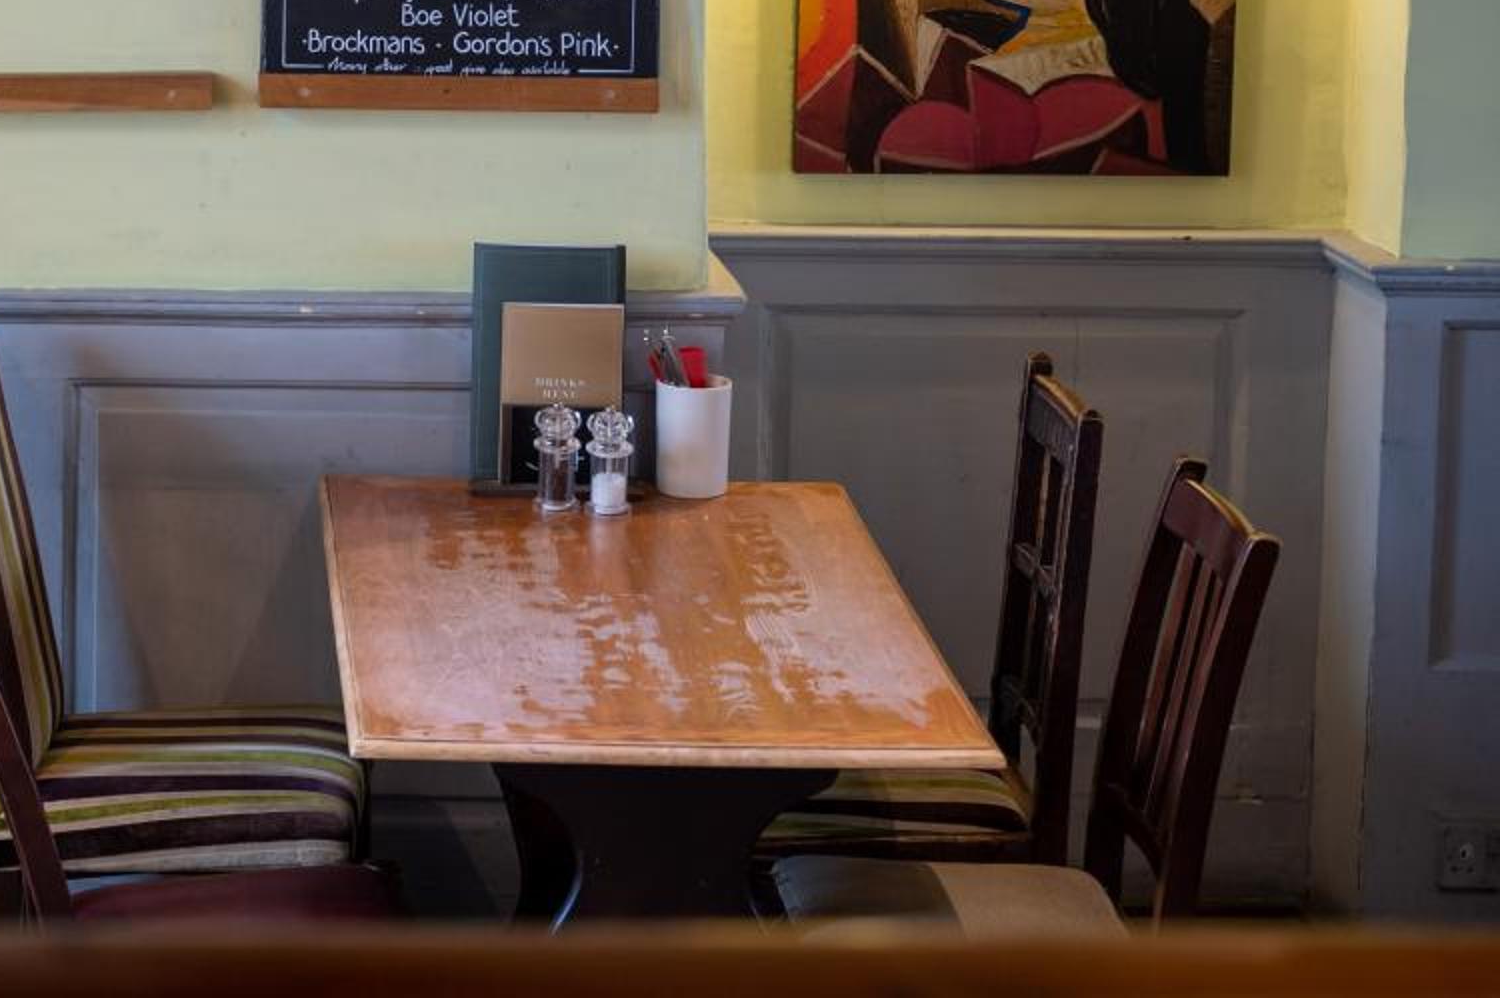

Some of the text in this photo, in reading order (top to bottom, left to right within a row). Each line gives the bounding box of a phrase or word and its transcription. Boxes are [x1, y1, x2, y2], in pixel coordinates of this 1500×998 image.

[401, 3, 520, 27] Boe Violet
[307, 30, 612, 57] Brockmans Gordon's Pink
